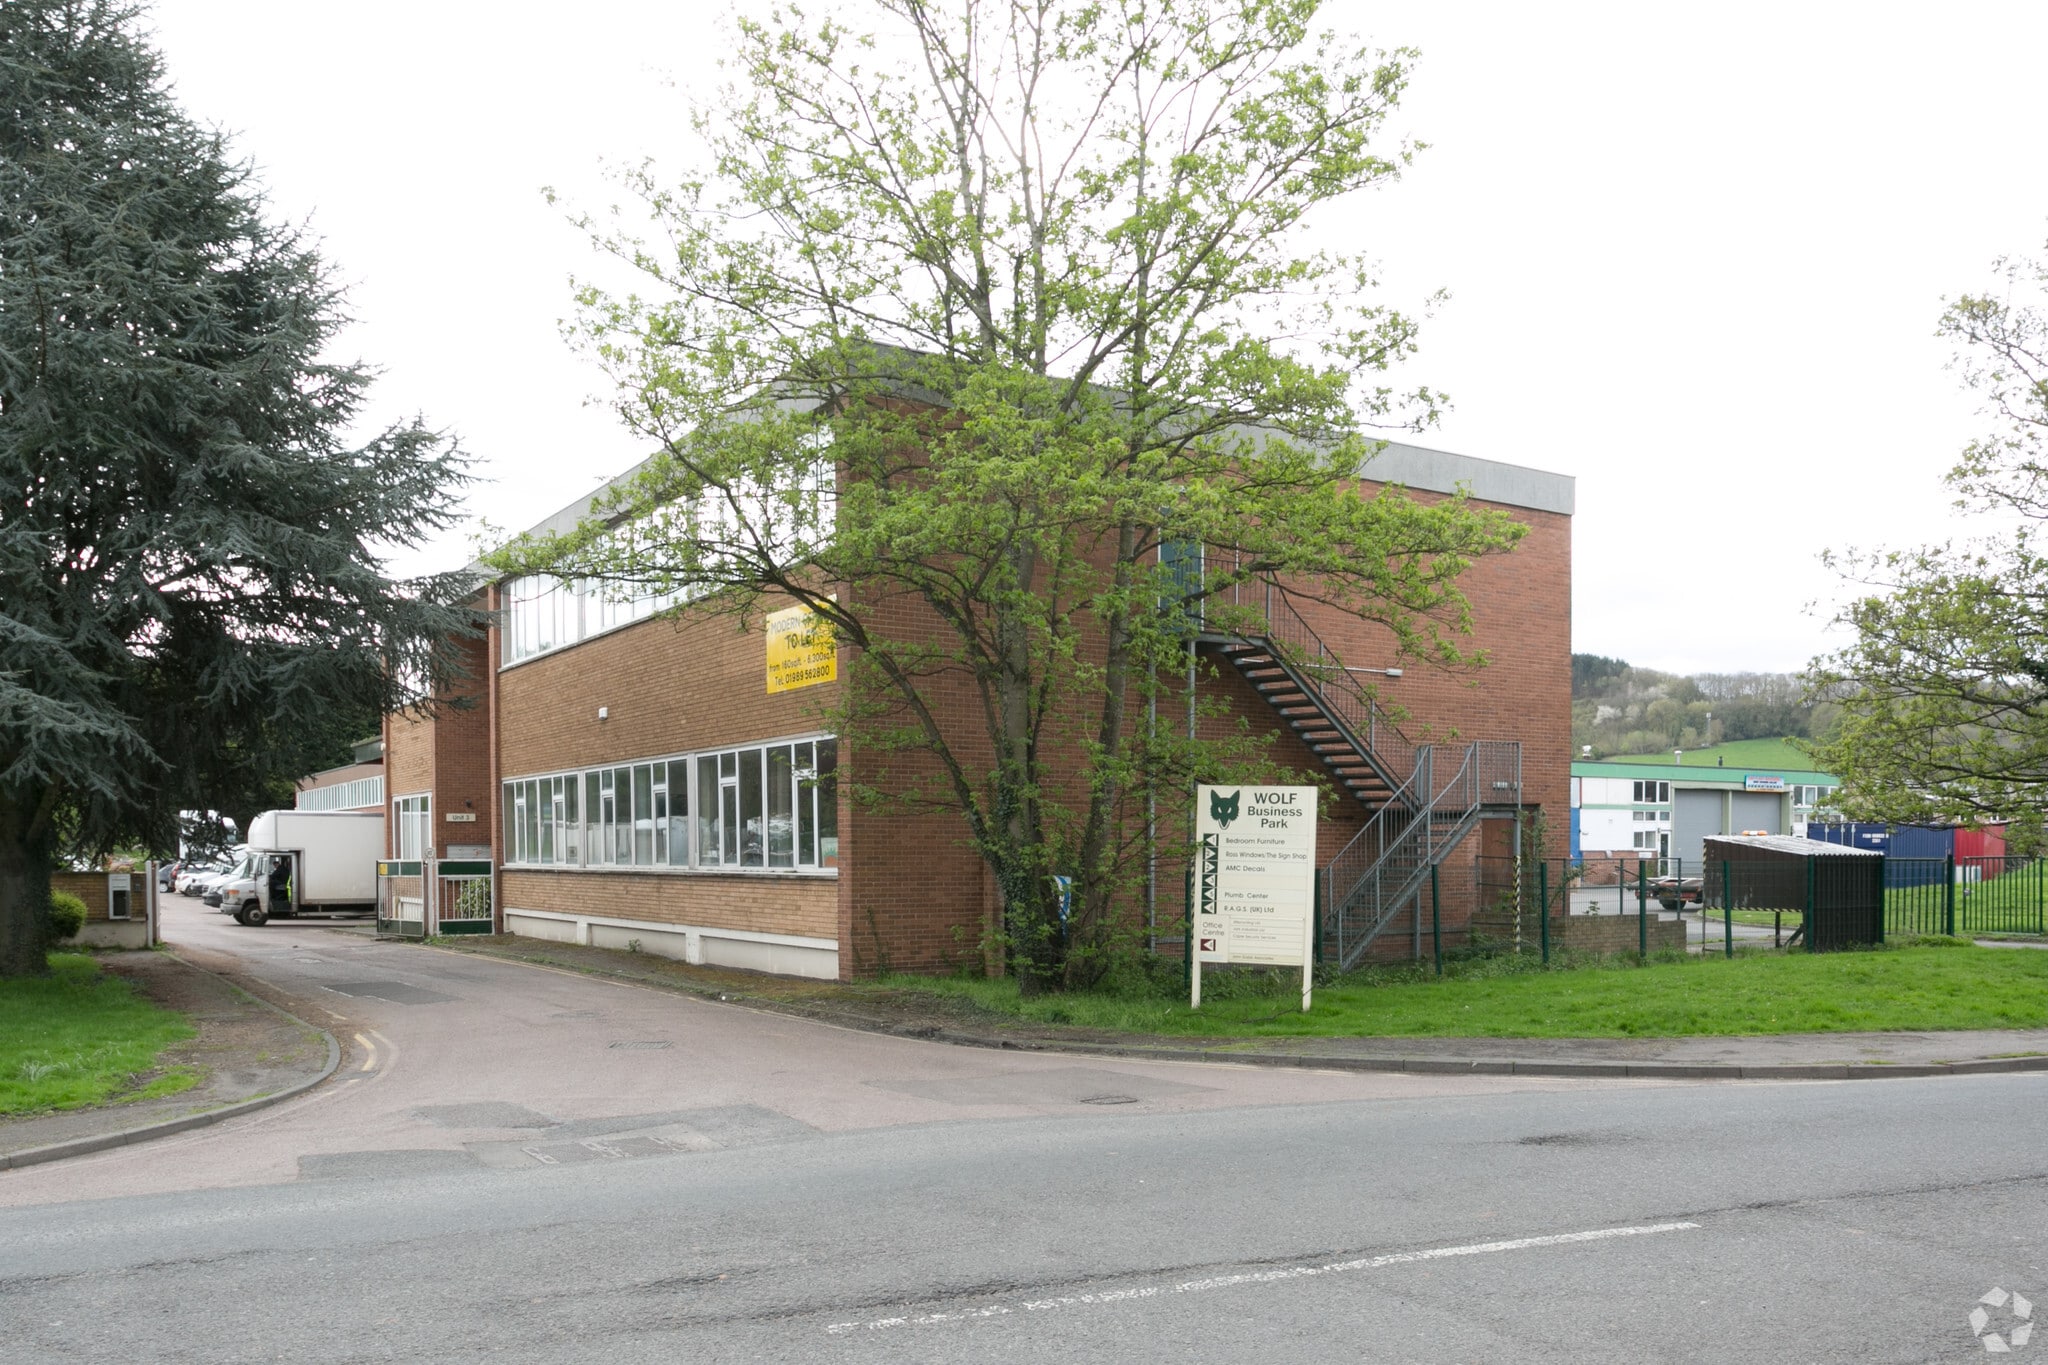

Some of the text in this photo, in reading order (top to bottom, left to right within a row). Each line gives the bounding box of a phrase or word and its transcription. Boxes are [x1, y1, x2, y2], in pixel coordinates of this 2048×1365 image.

[771, 617, 801, 634] MODERN
[785, 629, 816, 649] TO LET
[785, 671, 804, 684] 01989
[805, 665, 830, 680] 562800
[1254, 793, 1298, 805] WOLF
[1247, 806, 1303, 817] Business
[1261, 819, 1288, 829] Park
[1203, 921, 1223, 929] Office
